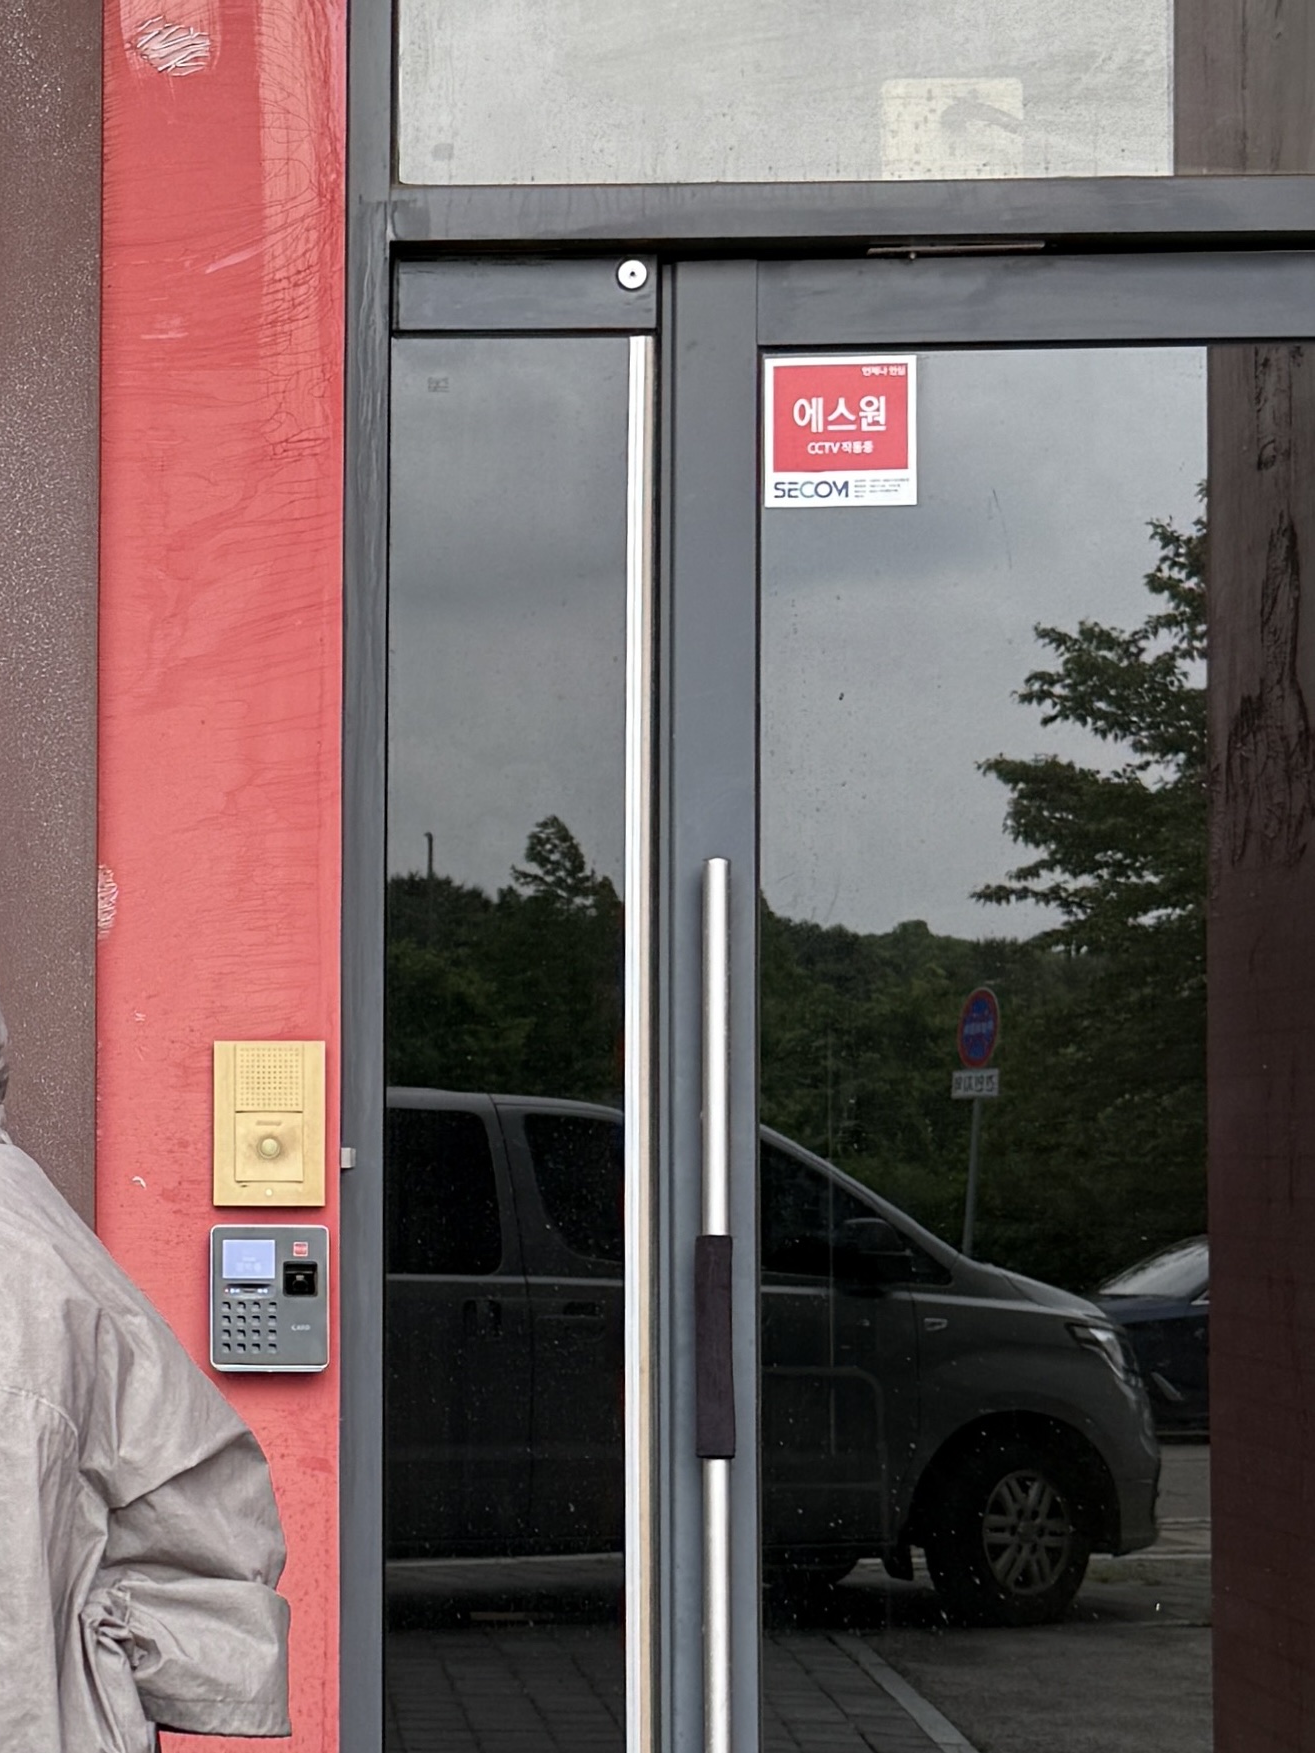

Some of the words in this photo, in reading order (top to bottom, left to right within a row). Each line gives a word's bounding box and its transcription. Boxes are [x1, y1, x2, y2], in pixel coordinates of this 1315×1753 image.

[792, 395, 887, 433] 에스원
[807, 441, 840, 455] CCTV
[773, 480, 850, 499] SECOM
